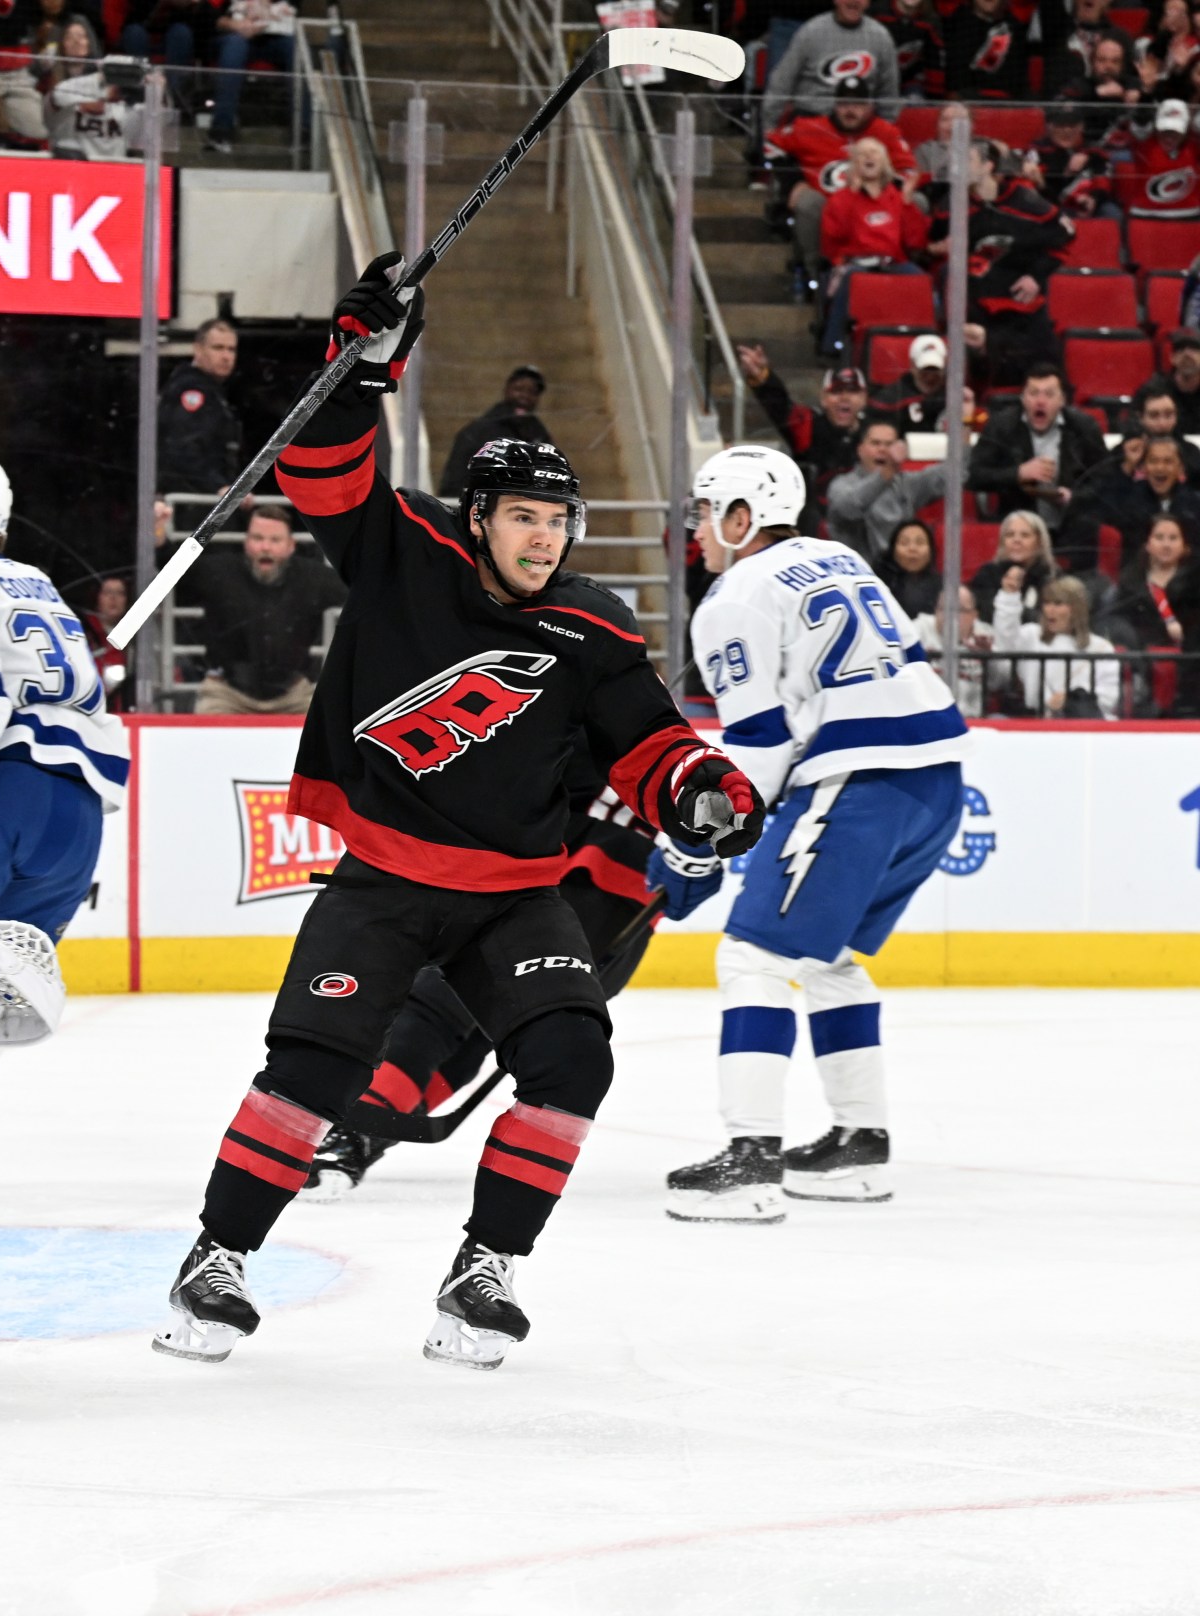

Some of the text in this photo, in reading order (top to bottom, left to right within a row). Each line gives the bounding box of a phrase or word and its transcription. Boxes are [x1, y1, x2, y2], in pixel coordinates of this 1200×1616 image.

[432, 131, 541, 263] TRUE
[534, 469, 571, 481] CCM
[538, 620, 585, 641] NUCOR
[800, 581, 903, 694] 29
[7, 608, 104, 717] 37
[706, 638, 752, 700] 29
[268, 813, 347, 866] MI
[513, 956, 592, 976] CCM
